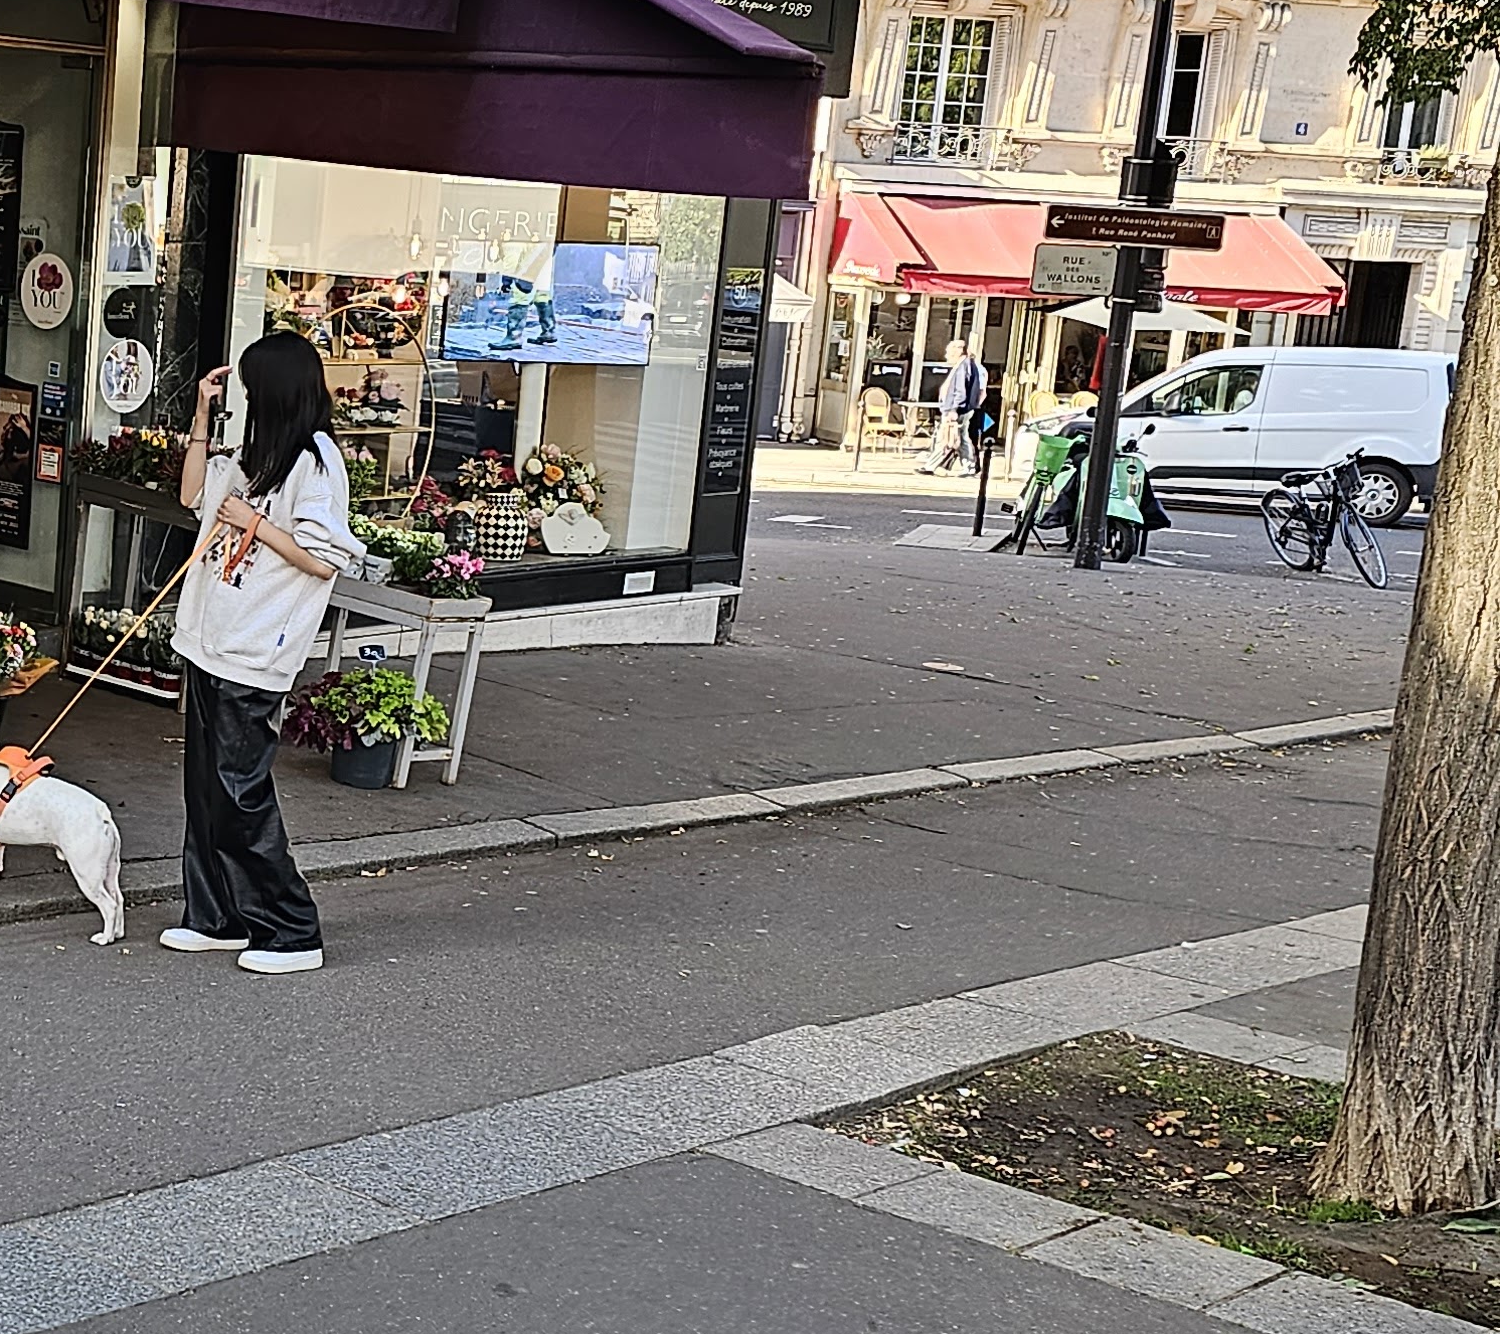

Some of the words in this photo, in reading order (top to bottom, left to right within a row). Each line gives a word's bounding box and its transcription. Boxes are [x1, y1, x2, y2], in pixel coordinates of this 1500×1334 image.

[780, 1, 813, 18] 1989
[1064, 213, 1097, 222] Institut
[1100, 214, 1109, 222] de
[1111, 216, 1168, 228] Paléontologie
[1171, 220, 1208, 229] Humaine
[1098, 227, 1115, 235] Rue
[1118, 228, 1138, 237] René
[1063, 256, 1086, 265] RUE
[1046, 273, 1101, 284] WALLONS
[31, 289, 61, 309] YOU
